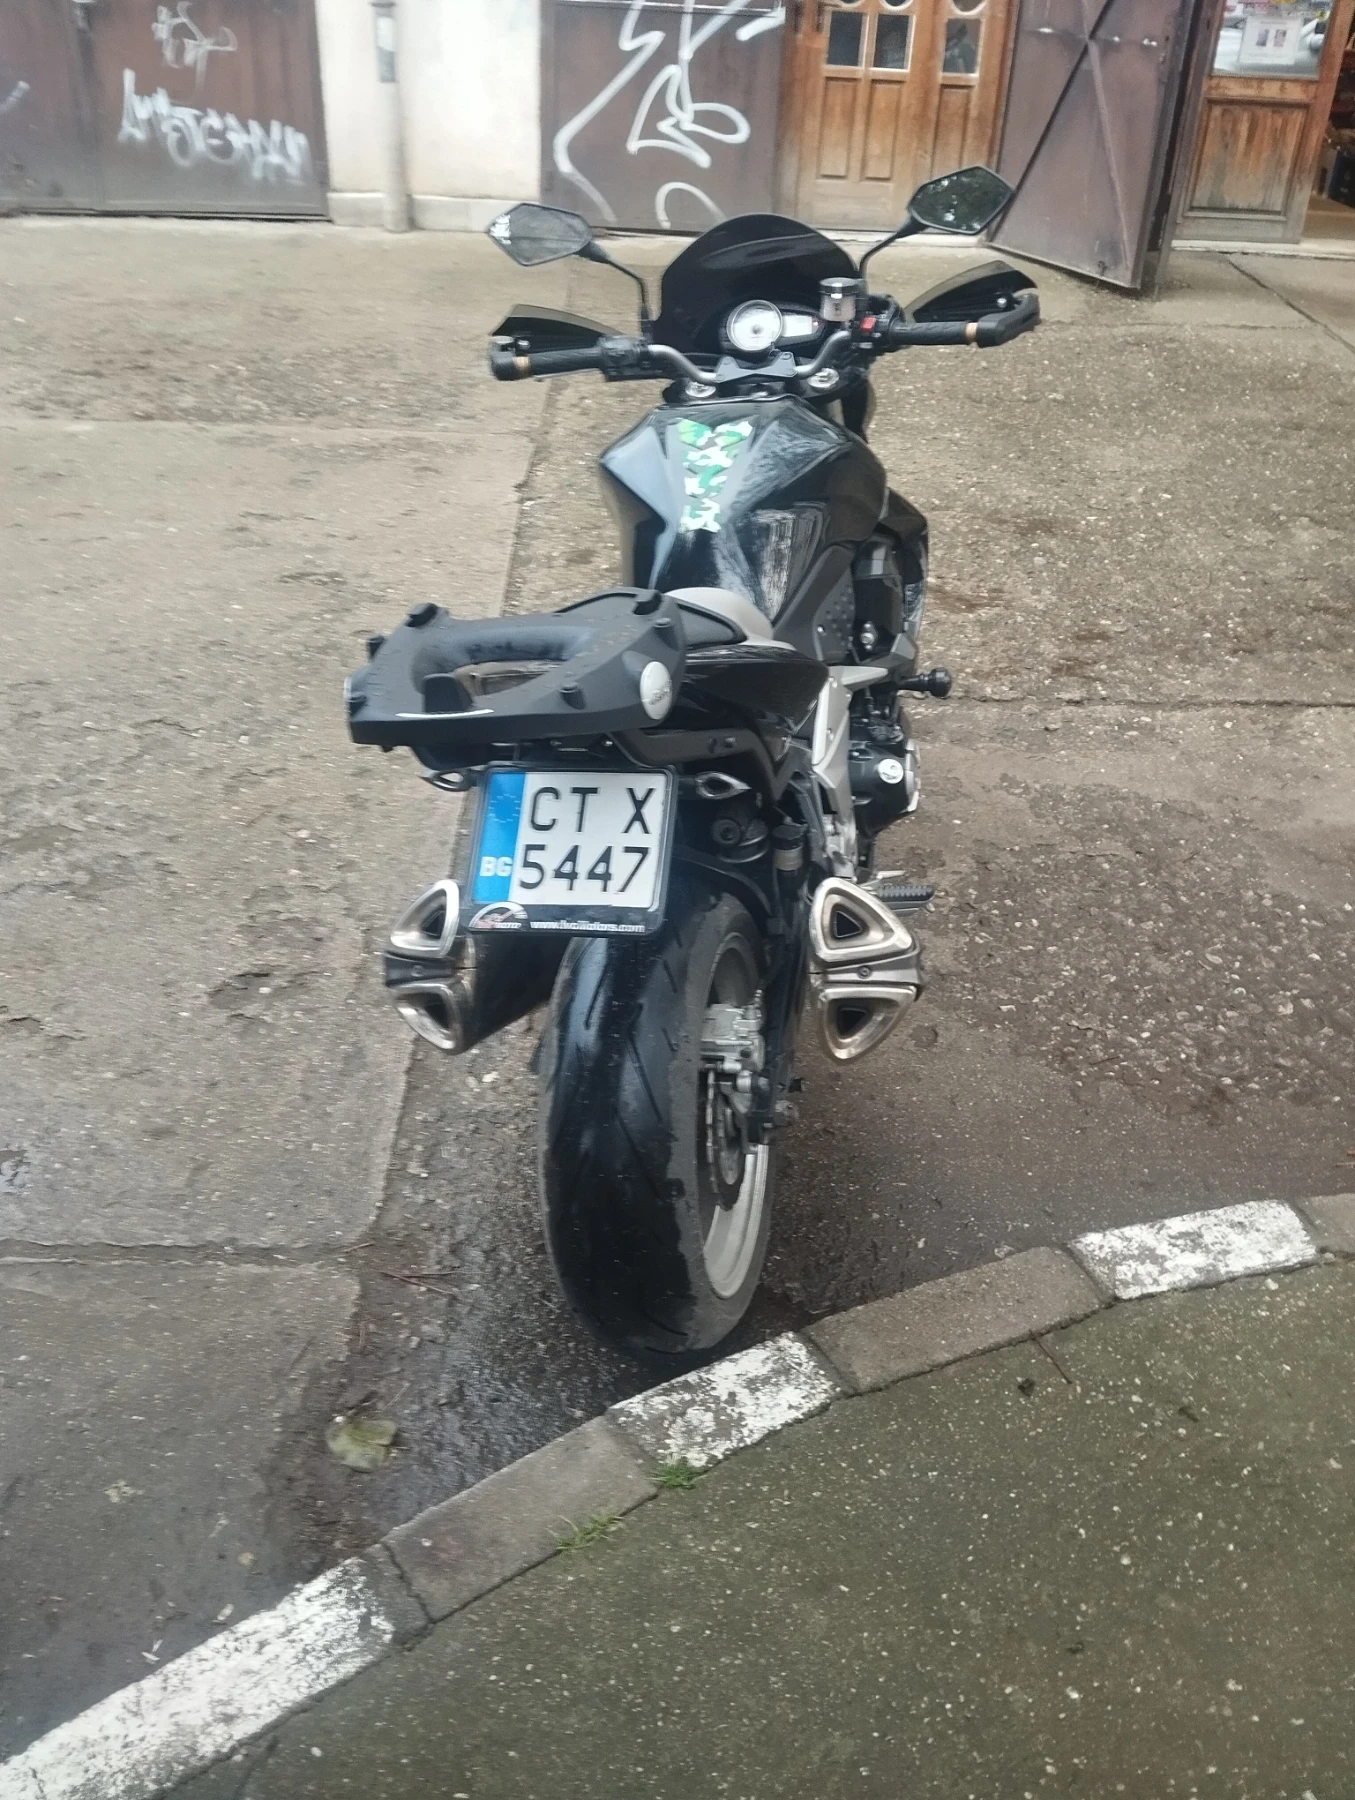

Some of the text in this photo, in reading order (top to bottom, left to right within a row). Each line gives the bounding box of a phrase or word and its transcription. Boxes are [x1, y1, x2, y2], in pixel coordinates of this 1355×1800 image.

[530, 786, 656, 834] CT X
[479, 856, 513, 877] BG
[519, 843, 651, 893] 5447
